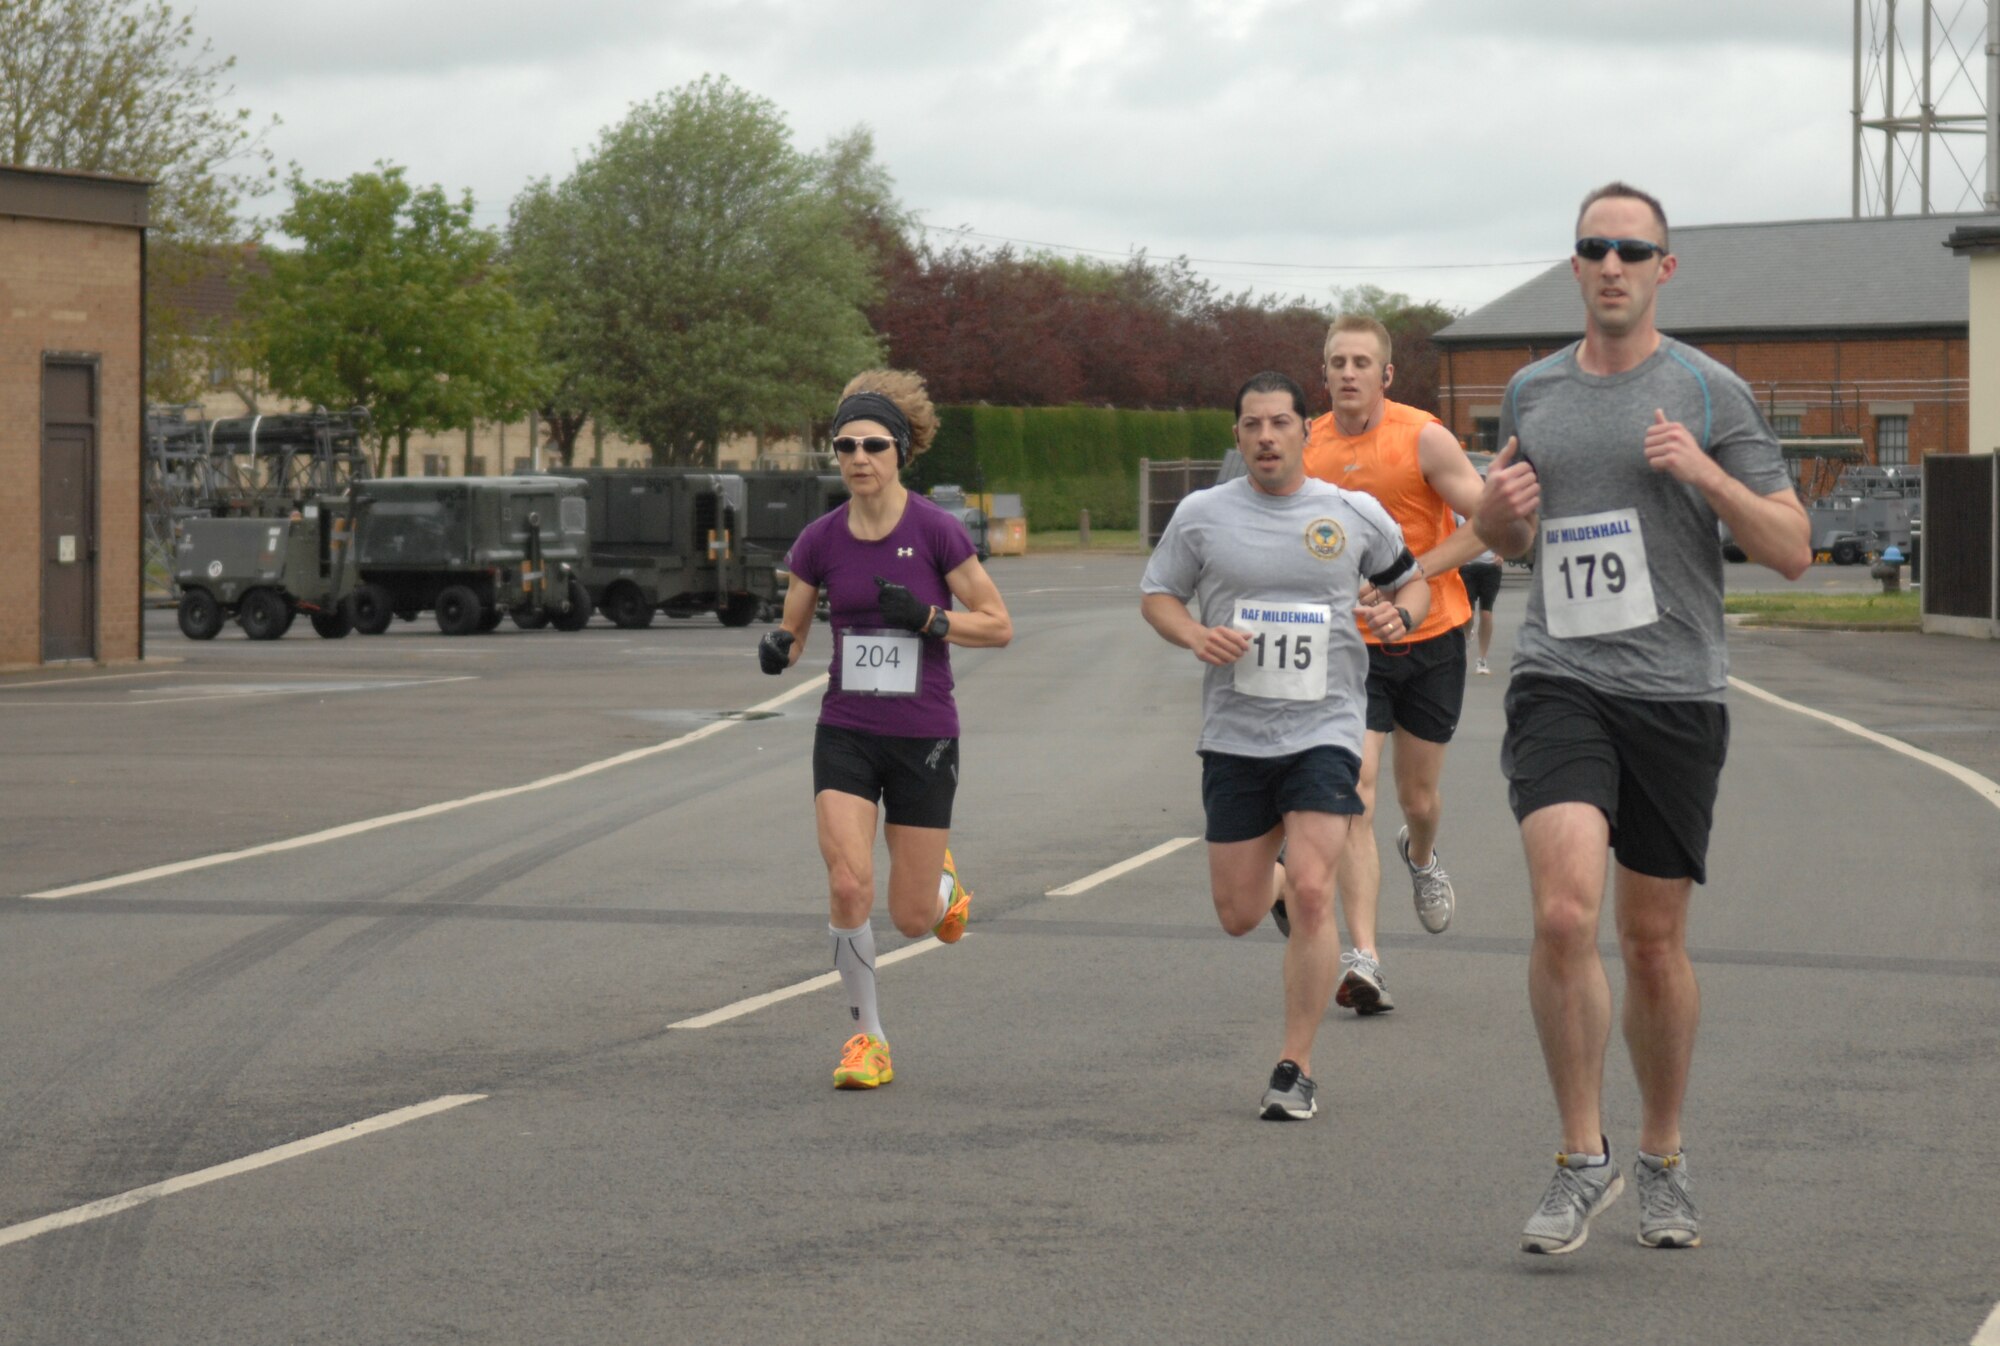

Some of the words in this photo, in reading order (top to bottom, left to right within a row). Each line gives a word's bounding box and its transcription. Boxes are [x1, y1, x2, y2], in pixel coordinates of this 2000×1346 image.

[1561, 519, 1632, 542] MILDENHALL
[1558, 551, 1627, 600] 179
[1241, 608, 1260, 621] RAF
[1262, 610, 1325, 624] MILDENHALL
[855, 644, 901, 669] 204
[1253, 632, 1312, 670] 115
